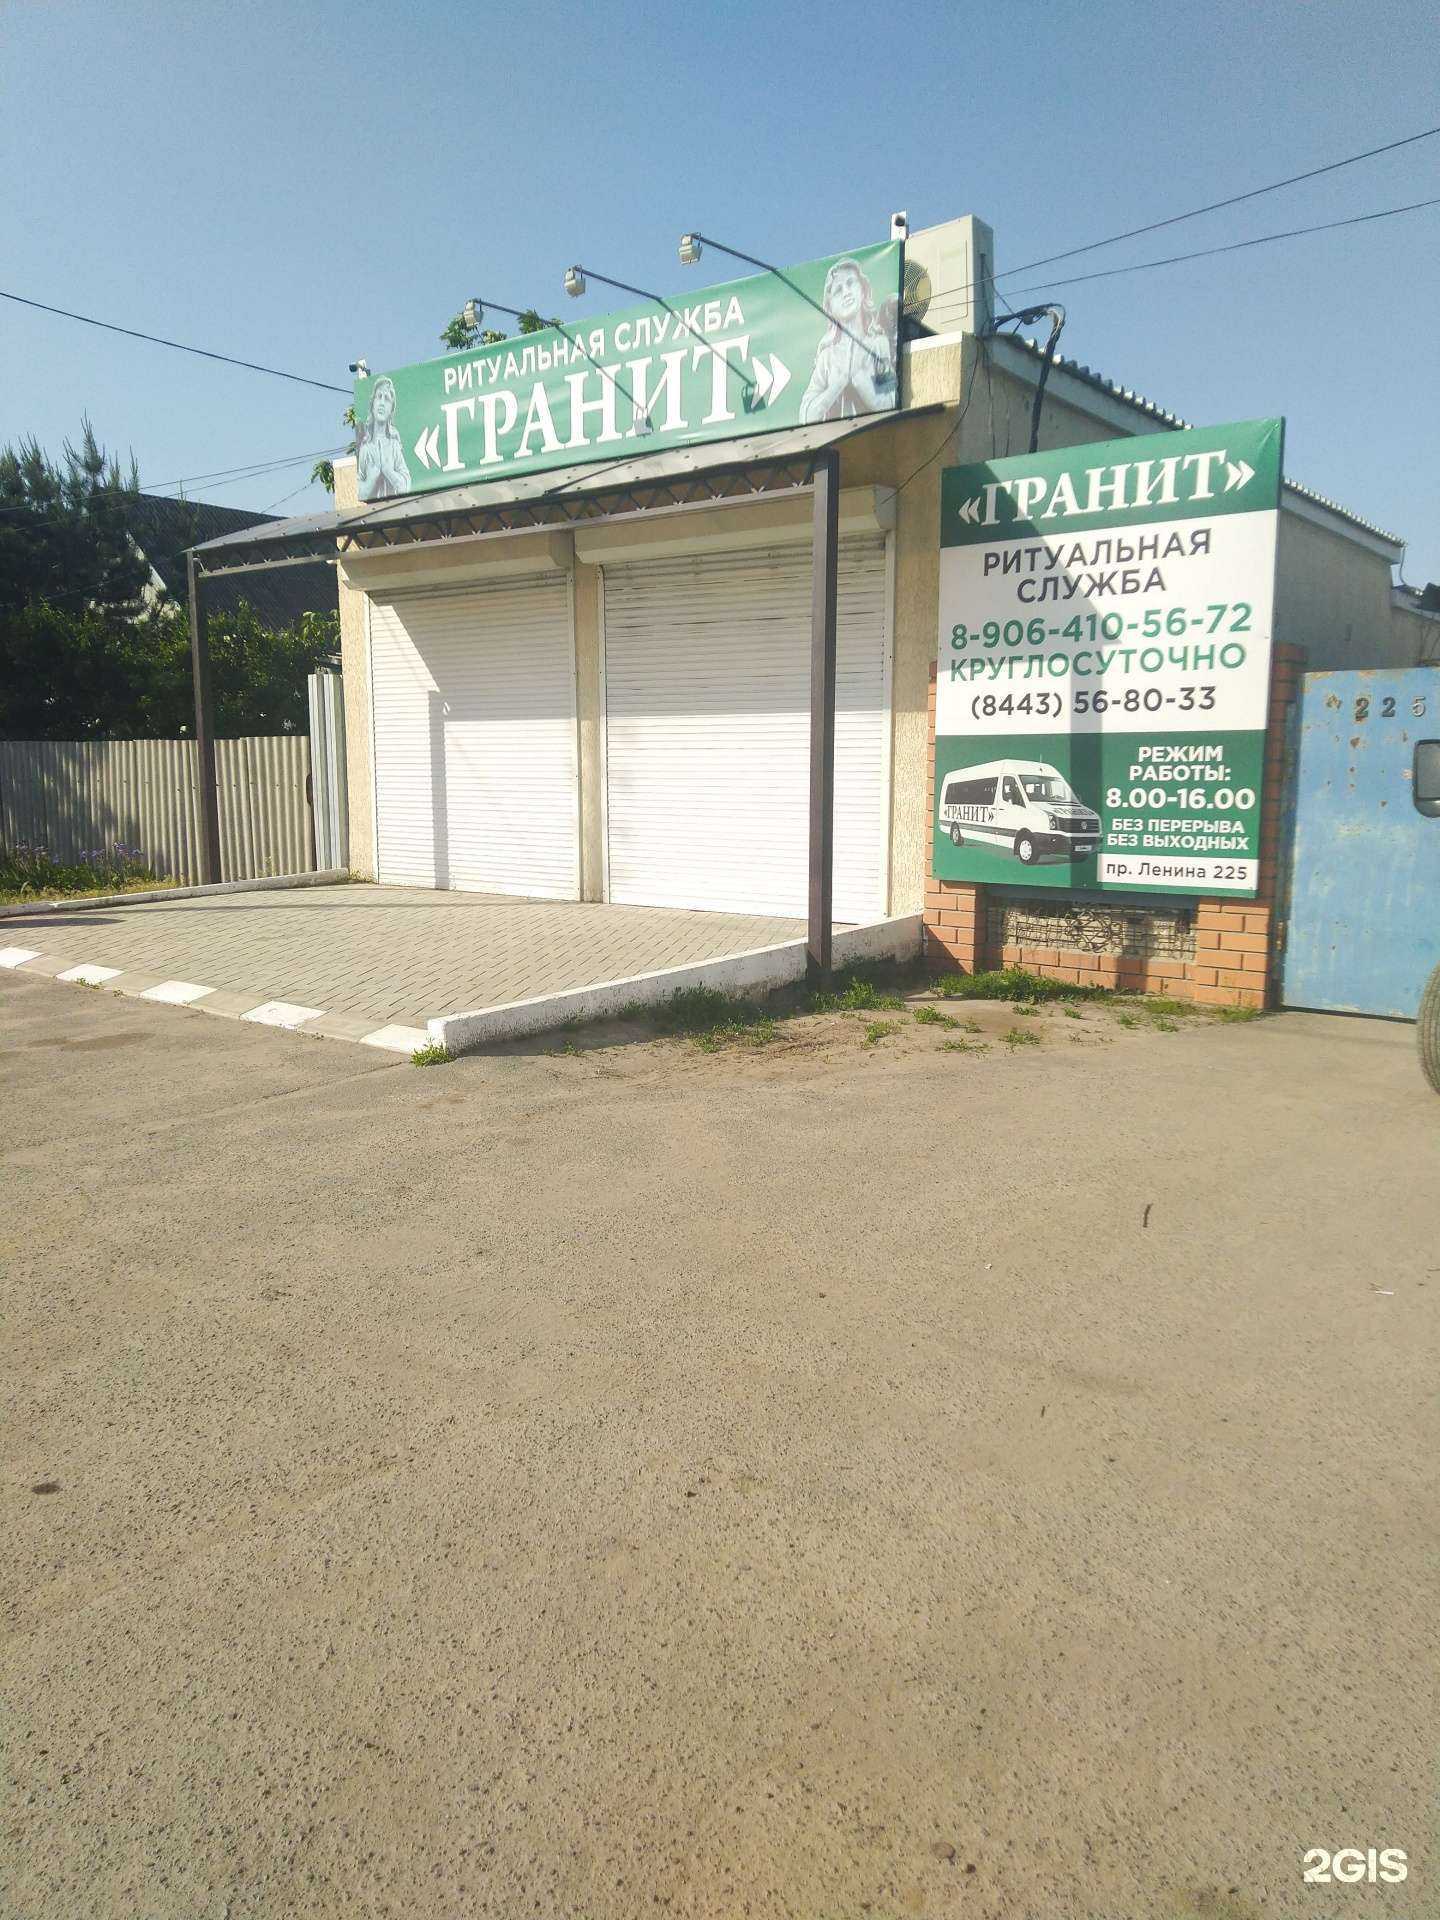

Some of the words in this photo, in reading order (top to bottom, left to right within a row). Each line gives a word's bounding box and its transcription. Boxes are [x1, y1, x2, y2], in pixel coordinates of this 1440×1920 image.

[444, 328, 606, 394] РИТУАЛЬНАЯ
[614, 296, 745, 352] СЛУЖБА
[413, 335, 792, 472] «ГРАНИТ»
[958, 449, 1255, 527] «ГРАНИТ»
[983, 528, 1212, 577] РИТУАЛЬНАЯ
[1017, 567, 1167, 603] СЛУЖБА
[950, 602, 1252, 650] 8-906-410-56-72
[950, 643, 1247, 682] КРУГЛОСУТОЧНО
[971, 692, 1063, 720] (8443)
[1073, 686, 1217, 714] 56-80-33
[1355, 696, 1426, 721] 225
[1138, 745, 1224, 762] РЕЖИМ
[1129, 765, 1231, 781] РАБОТЫ:
[1105, 787, 1256, 809] 8.00-16.00
[1107, 834, 1138, 847] БЕЗ
[1142, 835, 1249, 850] ВЫХОДНЫХ
[1111, 818, 1143, 831] БЕЗ
[1147, 819, 1245, 833] ПЕРЕРЫВА
[1106, 863, 1132, 877] пр.
[1138, 862, 1206, 878] Ленина
[1213, 865, 1248, 880] 225
